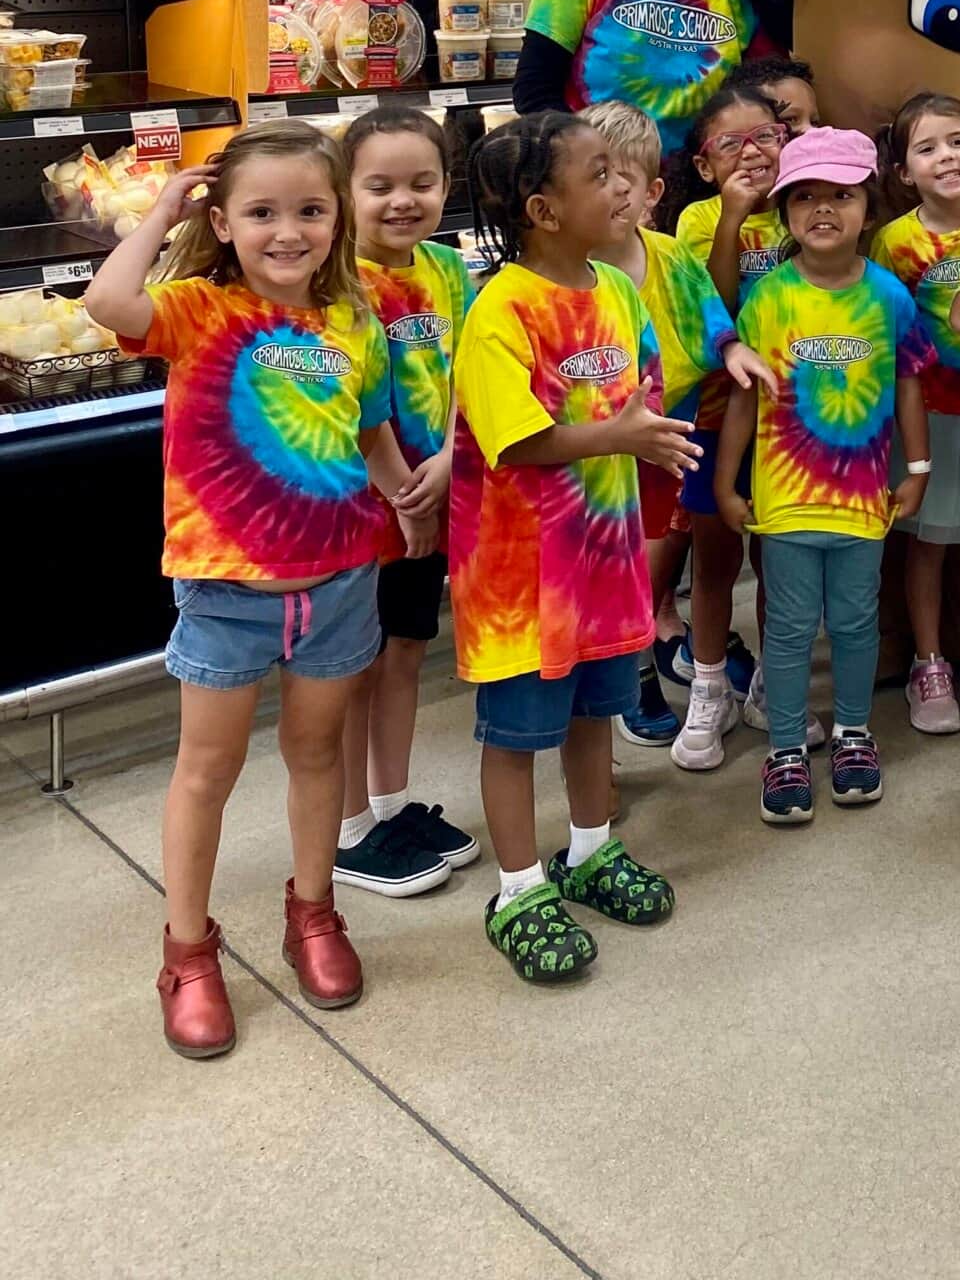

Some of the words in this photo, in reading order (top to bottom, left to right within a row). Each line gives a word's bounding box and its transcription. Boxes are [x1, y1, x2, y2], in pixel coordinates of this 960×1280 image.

[619, 3, 676, 37] PRIMROSE
[678, 10, 735, 41] SCHOOLS
[137, 134, 178, 149] NEW!
[259, 345, 307, 370] PRIMROSE
[307, 349, 351, 372] SCHOOLS
[794, 339, 833, 361] PRIMROSE
[835, 339, 870, 360] SCHOOLS
